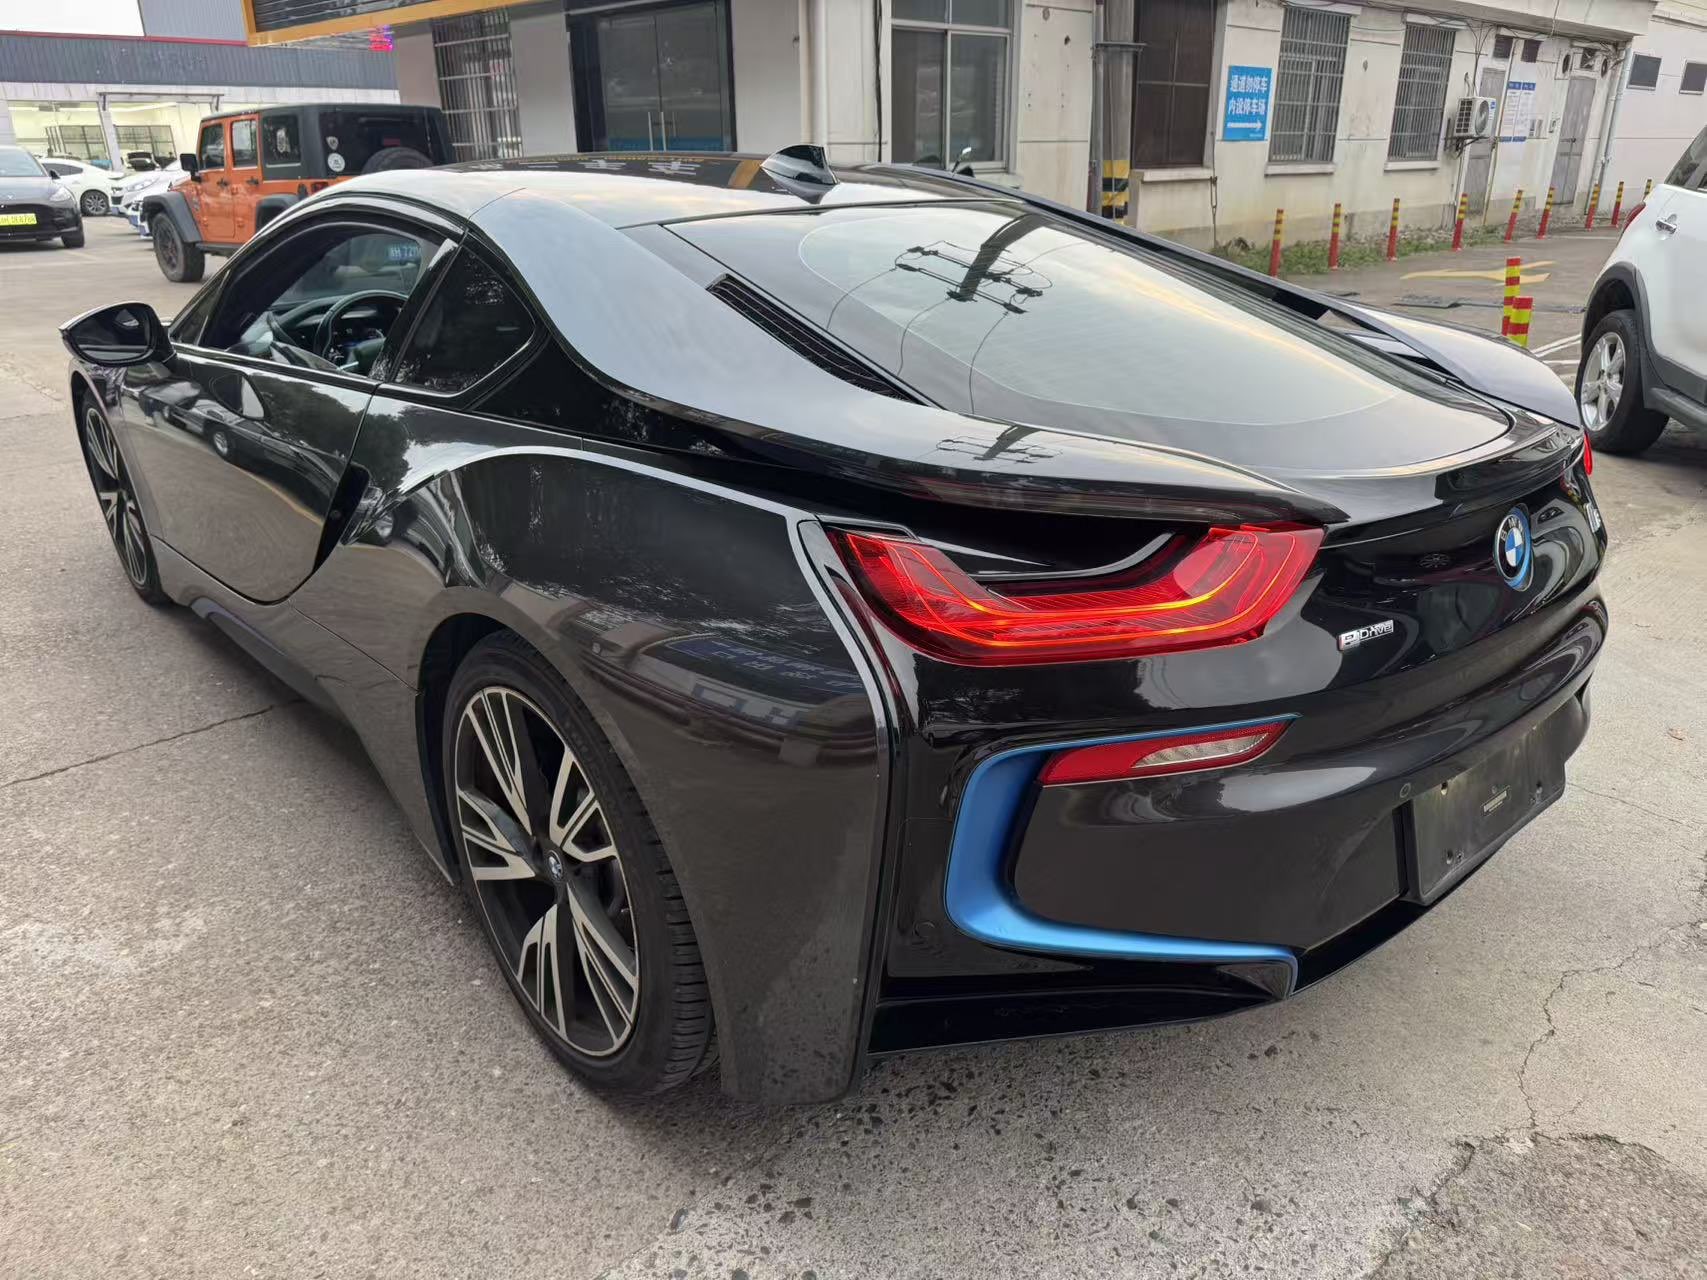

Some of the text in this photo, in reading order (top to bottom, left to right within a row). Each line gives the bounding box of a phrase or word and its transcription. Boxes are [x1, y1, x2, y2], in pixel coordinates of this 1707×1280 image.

[1230, 75, 1268, 93] 通道勿停车
[1228, 97, 1266, 115] 内设停车场
